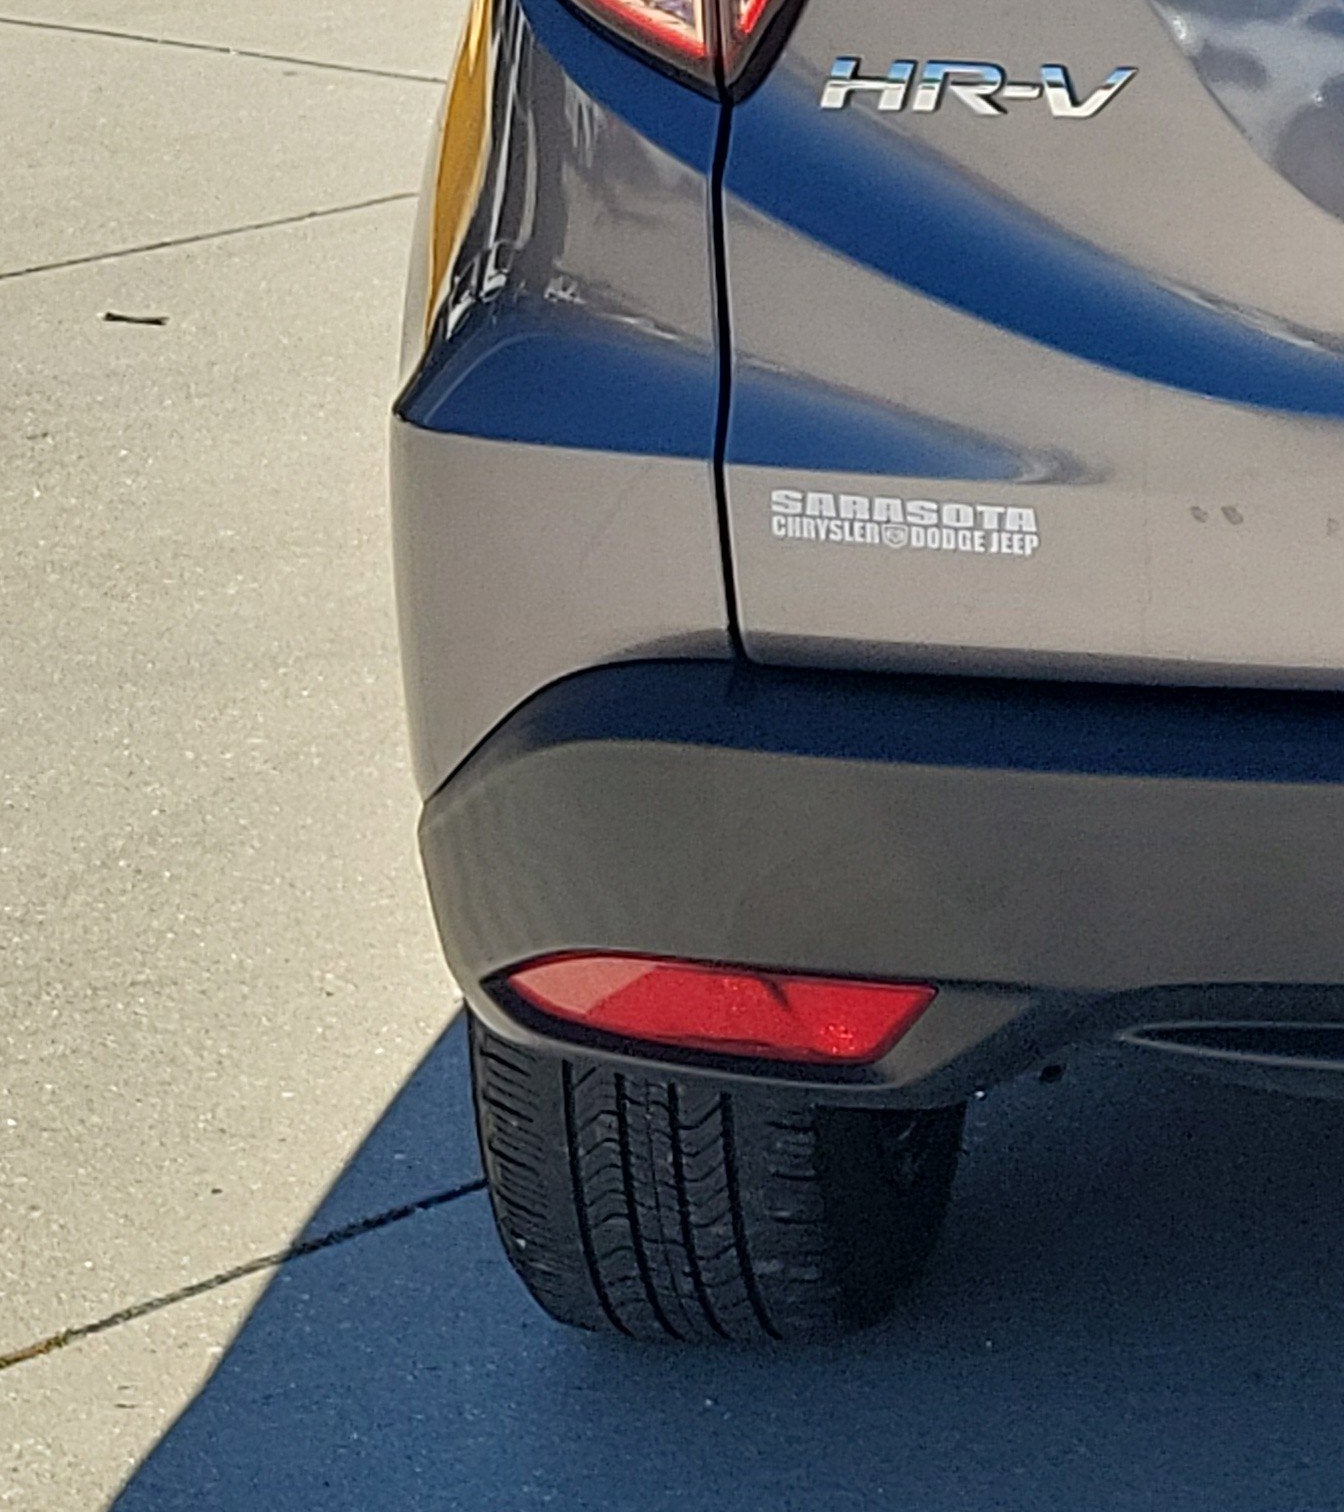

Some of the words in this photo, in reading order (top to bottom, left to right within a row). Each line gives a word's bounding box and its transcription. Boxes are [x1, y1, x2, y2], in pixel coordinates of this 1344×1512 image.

[820, 55, 1138, 120] HR-V
[771, 489, 1037, 532] SARASOTA
[772, 515, 880, 544] CHRYSLER
[911, 527, 986, 553] DODGE
[990, 533, 1039, 556] JEEP
